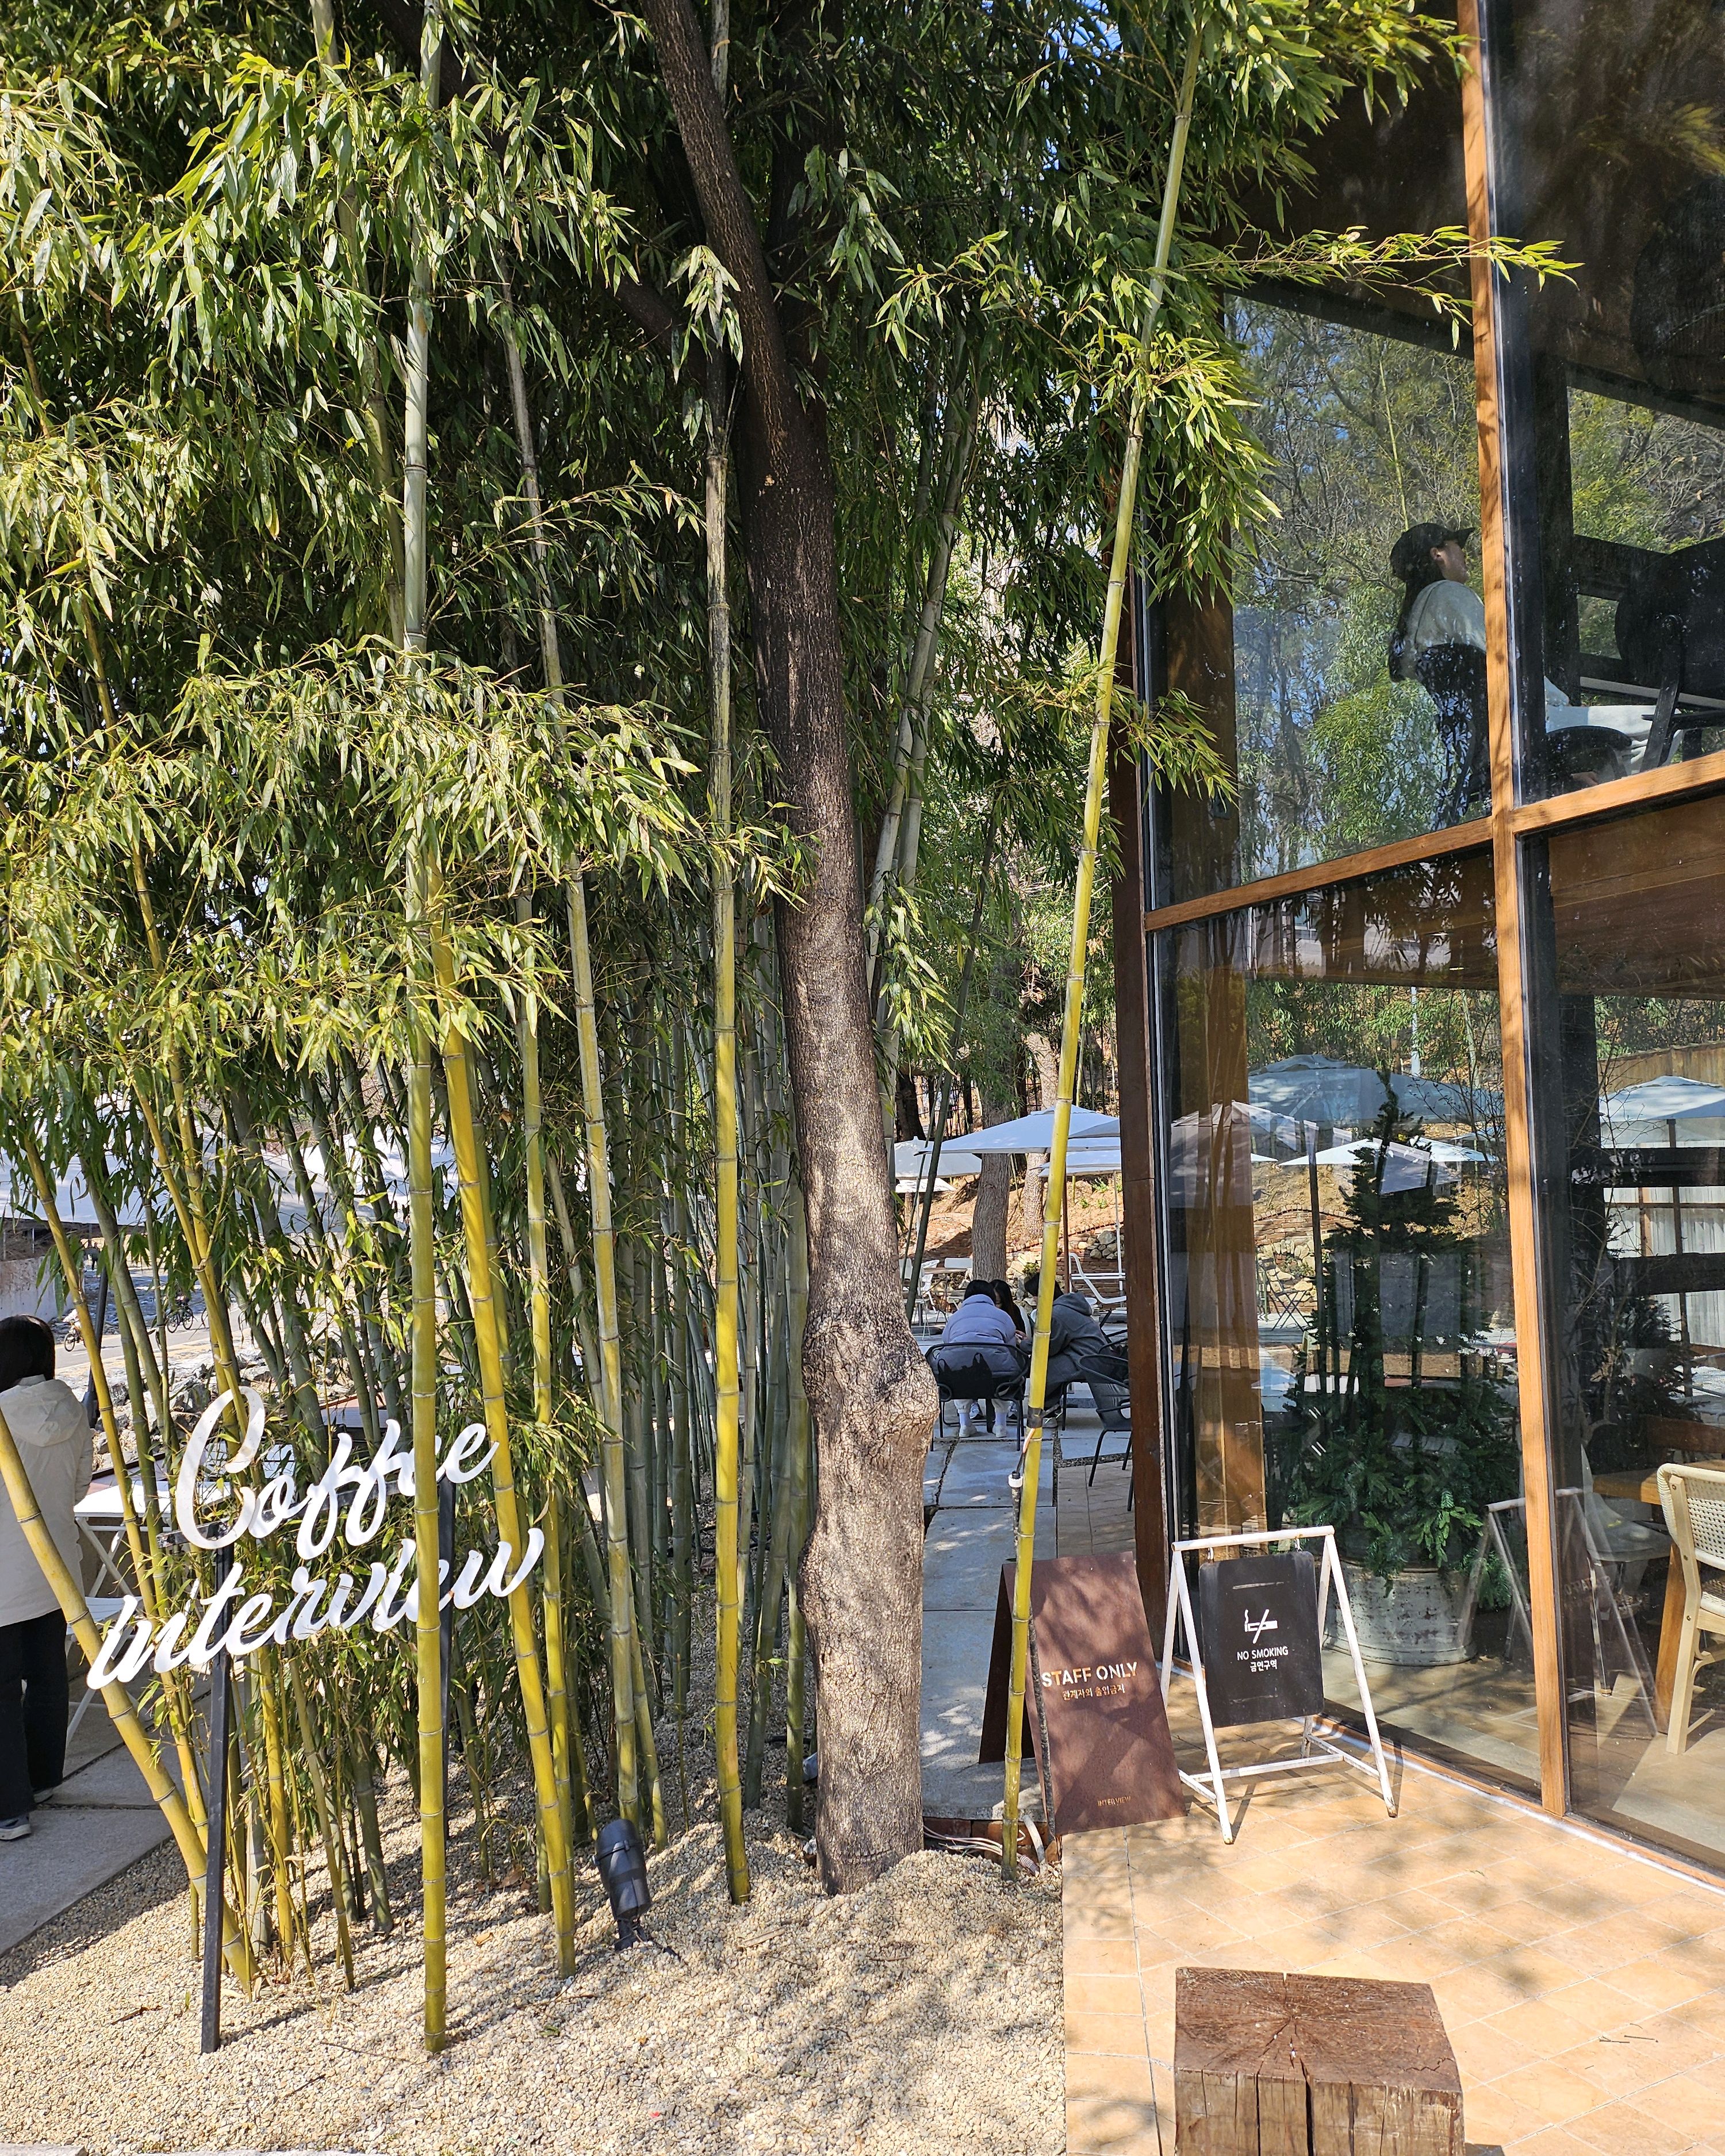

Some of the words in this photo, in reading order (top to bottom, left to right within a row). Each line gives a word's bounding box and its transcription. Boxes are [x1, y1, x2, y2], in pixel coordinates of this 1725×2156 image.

[1236, 1650, 1249, 1661] NO
[1251, 1645, 1289, 1660] SMOKING
[1249, 1659, 1278, 1672] 금연구역
[1041, 1667, 1092, 1687] STAFF
[1096, 1661, 1137, 1681] ONLY
[1062, 1687, 1093, 1701] 관계자외
[1094, 1682, 1126, 1697] 출입금지
[1097, 1795, 1131, 1807] INTERVIEW
